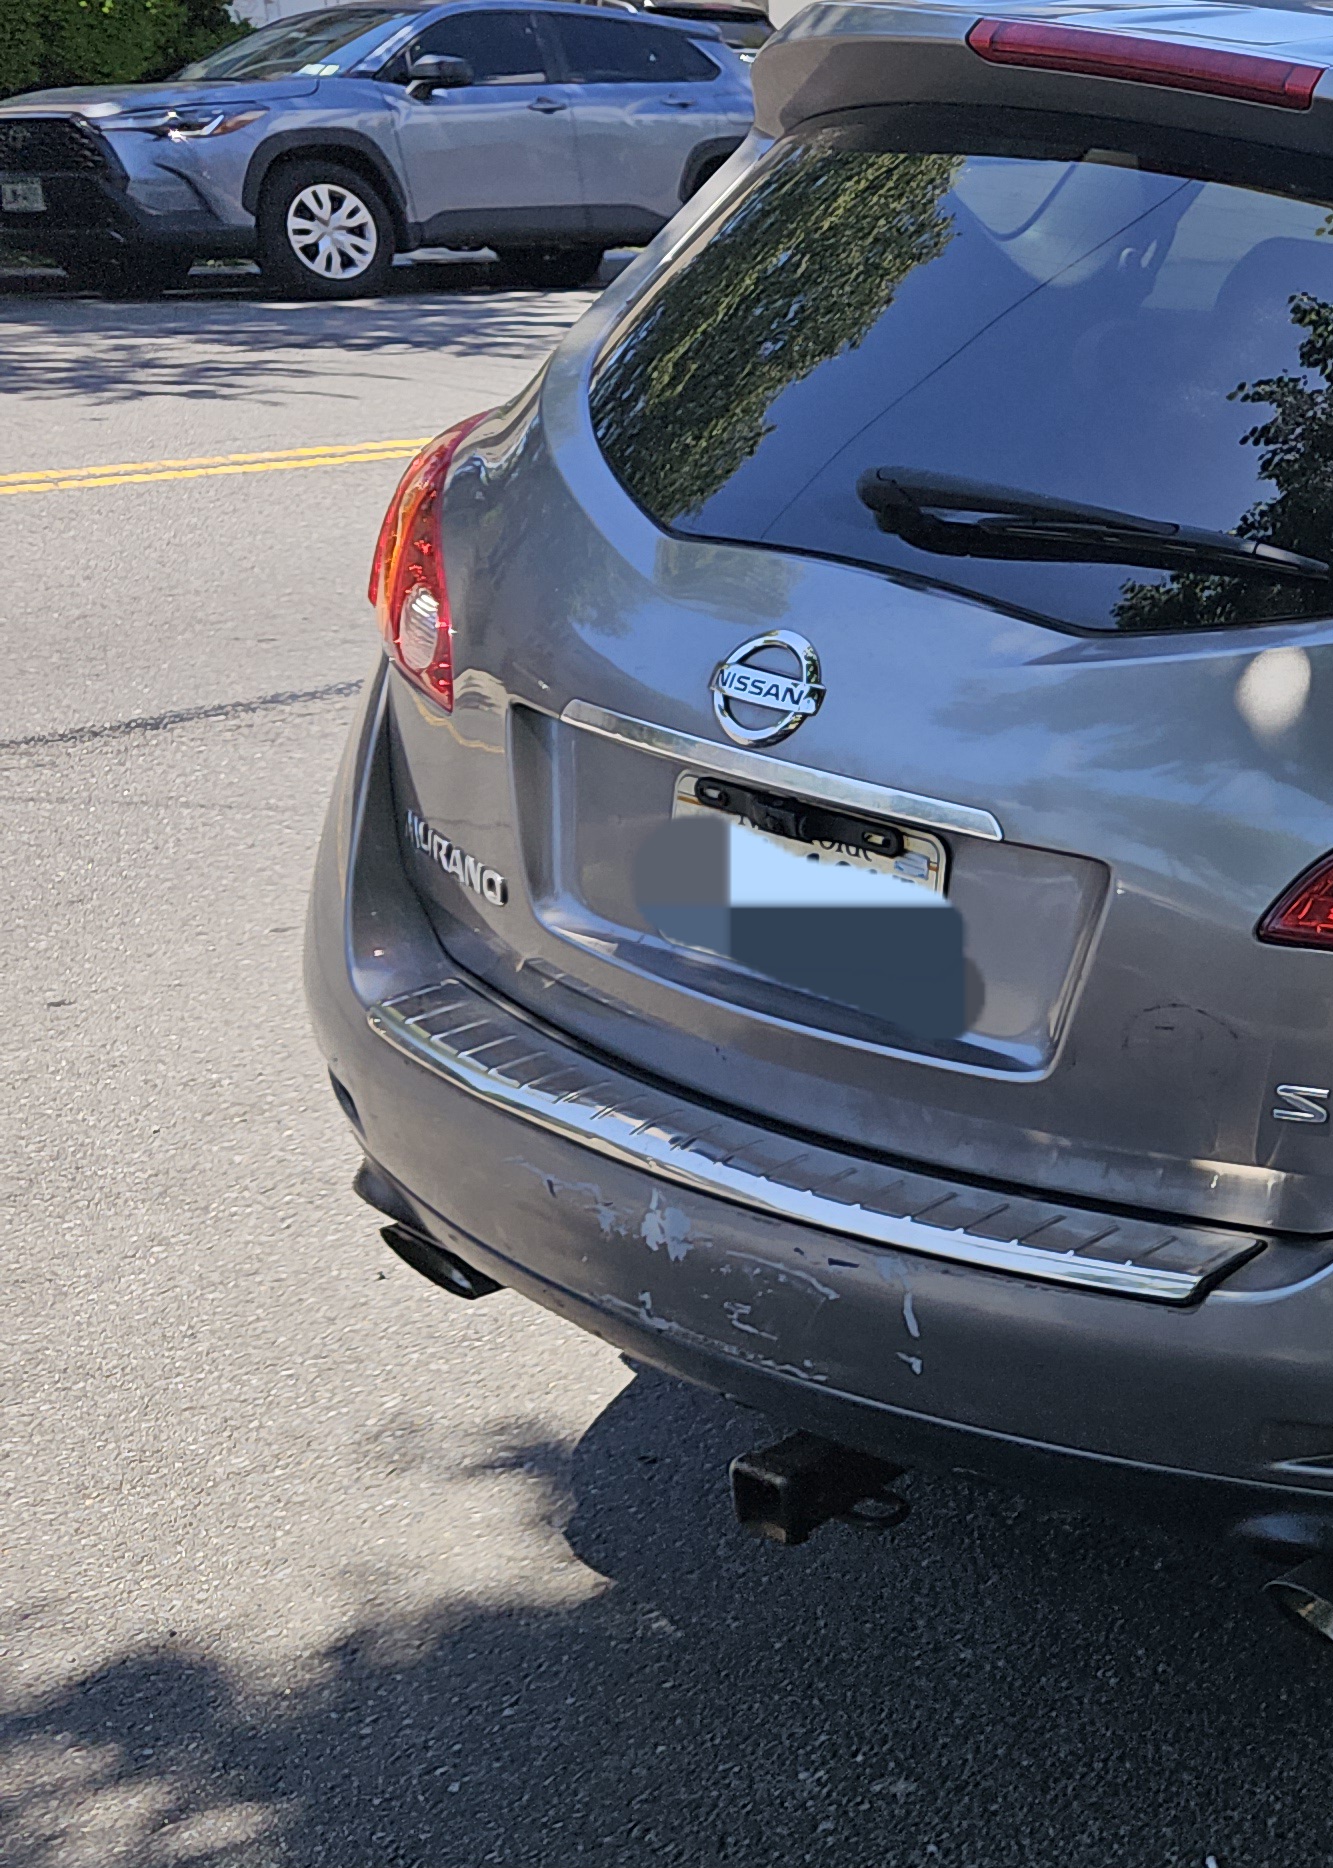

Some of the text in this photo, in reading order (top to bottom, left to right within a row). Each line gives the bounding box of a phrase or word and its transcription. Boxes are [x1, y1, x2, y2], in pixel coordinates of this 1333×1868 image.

[719, 669, 804, 705] NISSAN
[405, 809, 508, 906] MURANO
[1273, 1084, 1330, 1123] S
